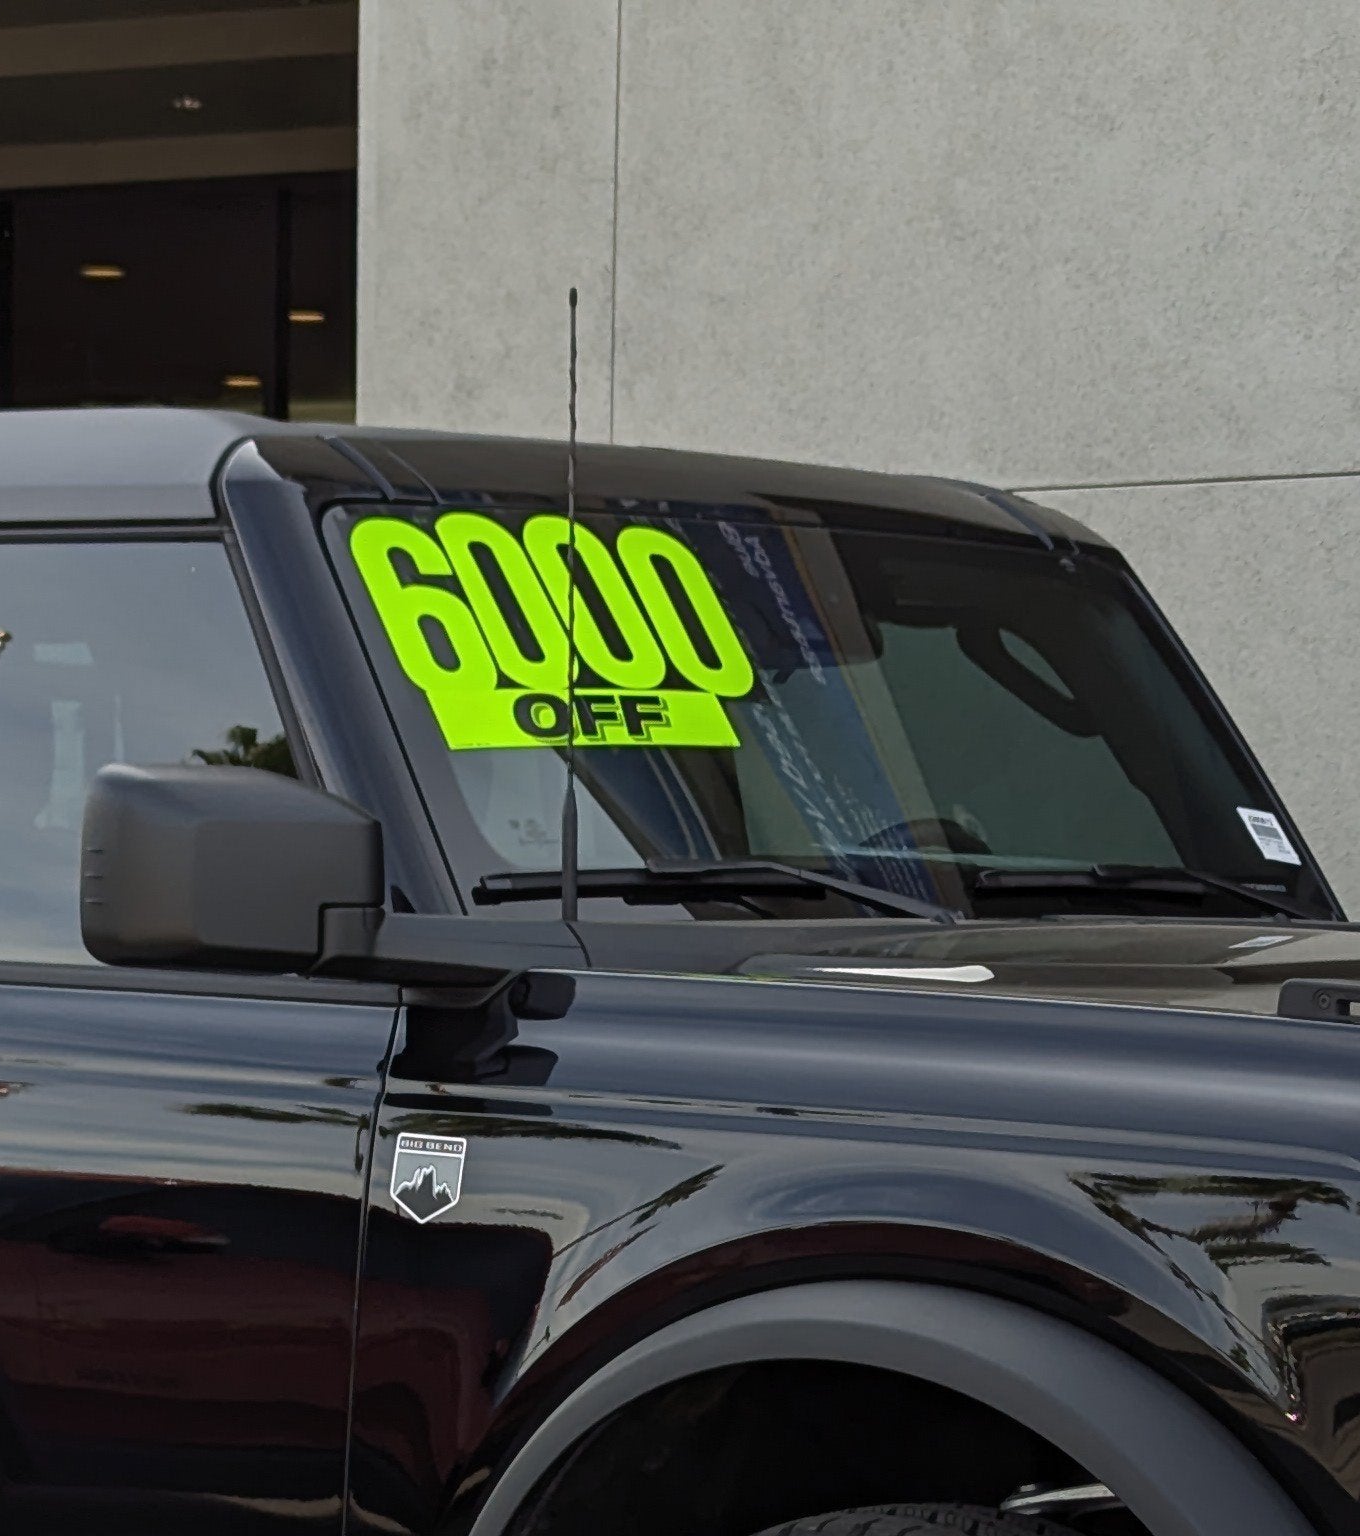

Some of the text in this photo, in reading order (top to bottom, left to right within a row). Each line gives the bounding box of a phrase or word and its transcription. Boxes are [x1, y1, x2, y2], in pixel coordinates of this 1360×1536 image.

[350, 511, 754, 697] 6000
[513, 693, 671, 744] OFF
[401, 1139, 463, 1152] BIG BEND
